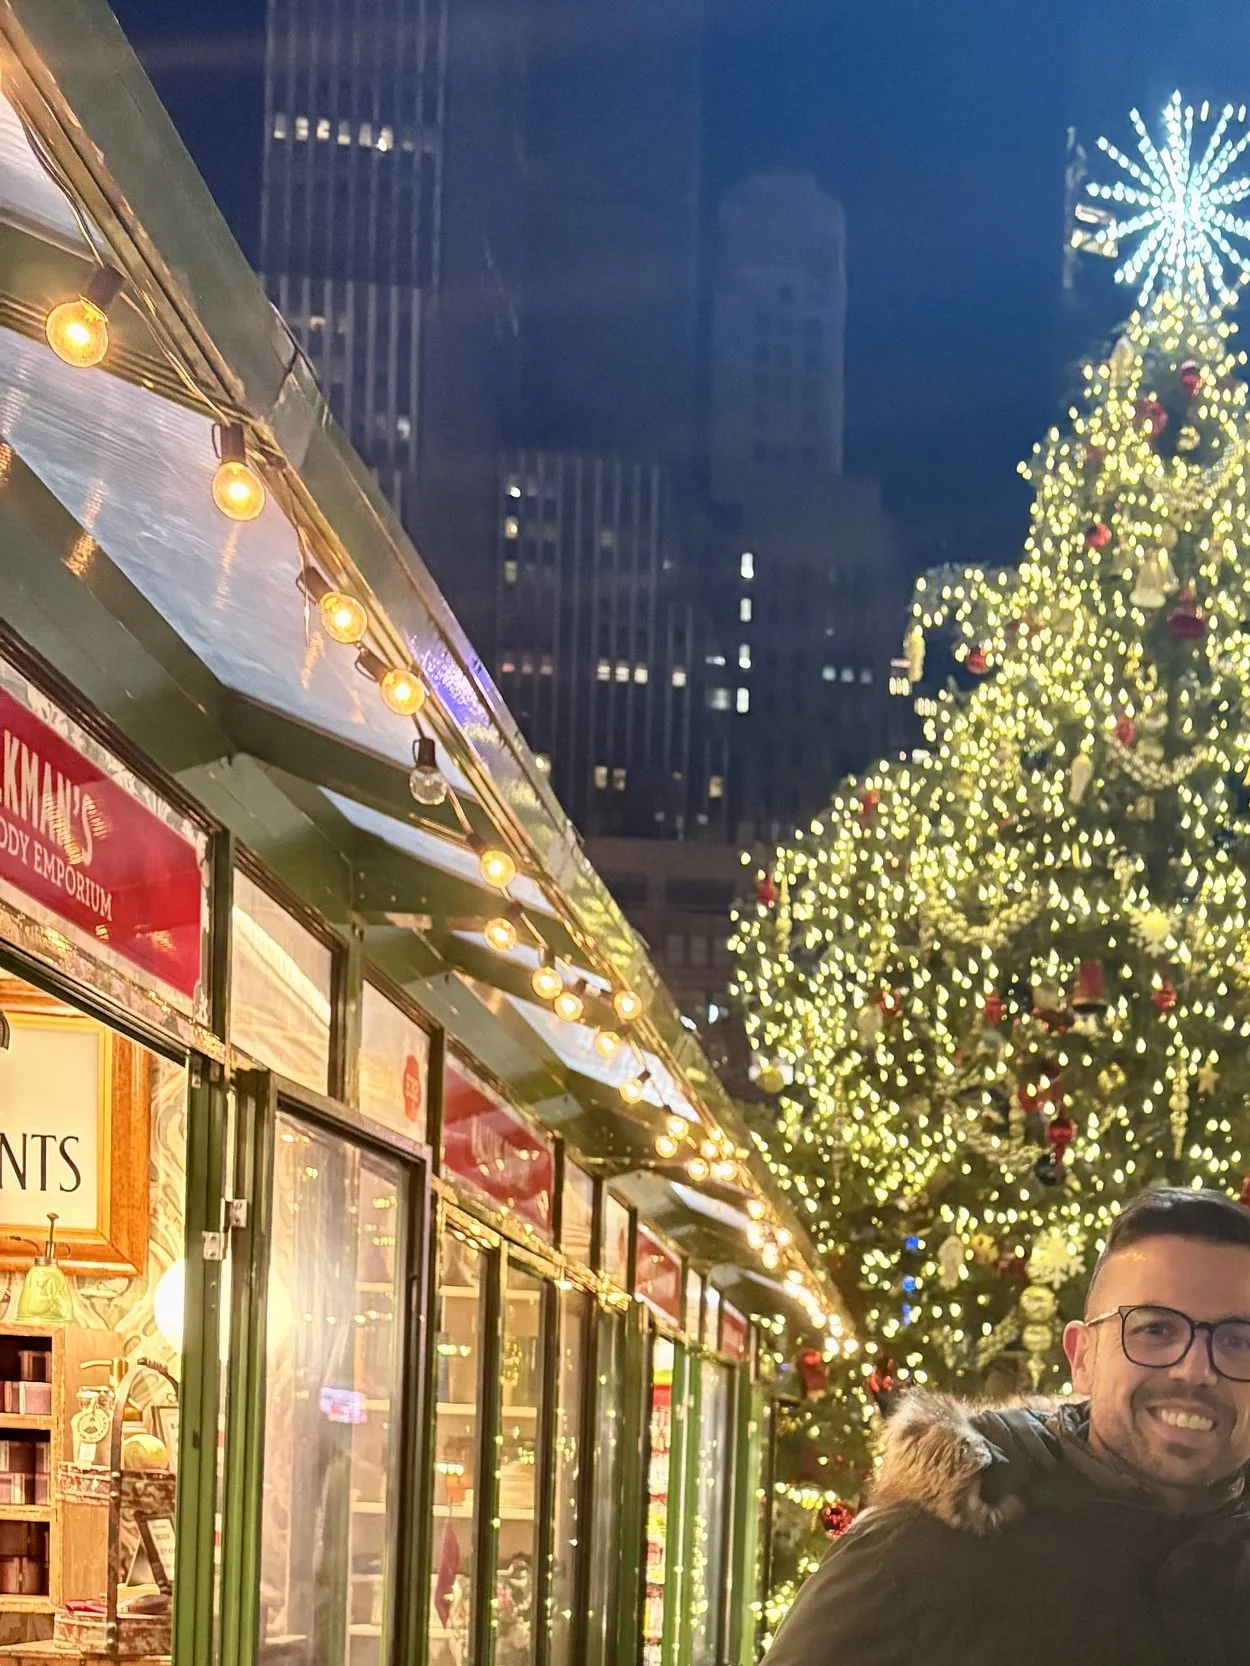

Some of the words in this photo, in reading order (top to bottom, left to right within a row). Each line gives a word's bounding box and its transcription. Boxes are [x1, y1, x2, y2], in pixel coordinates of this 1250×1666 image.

[0, 729, 93, 867] KMAN'S
[33, 840, 113, 922] EMPORIUM
[0, 1132, 81, 1193] NTS
